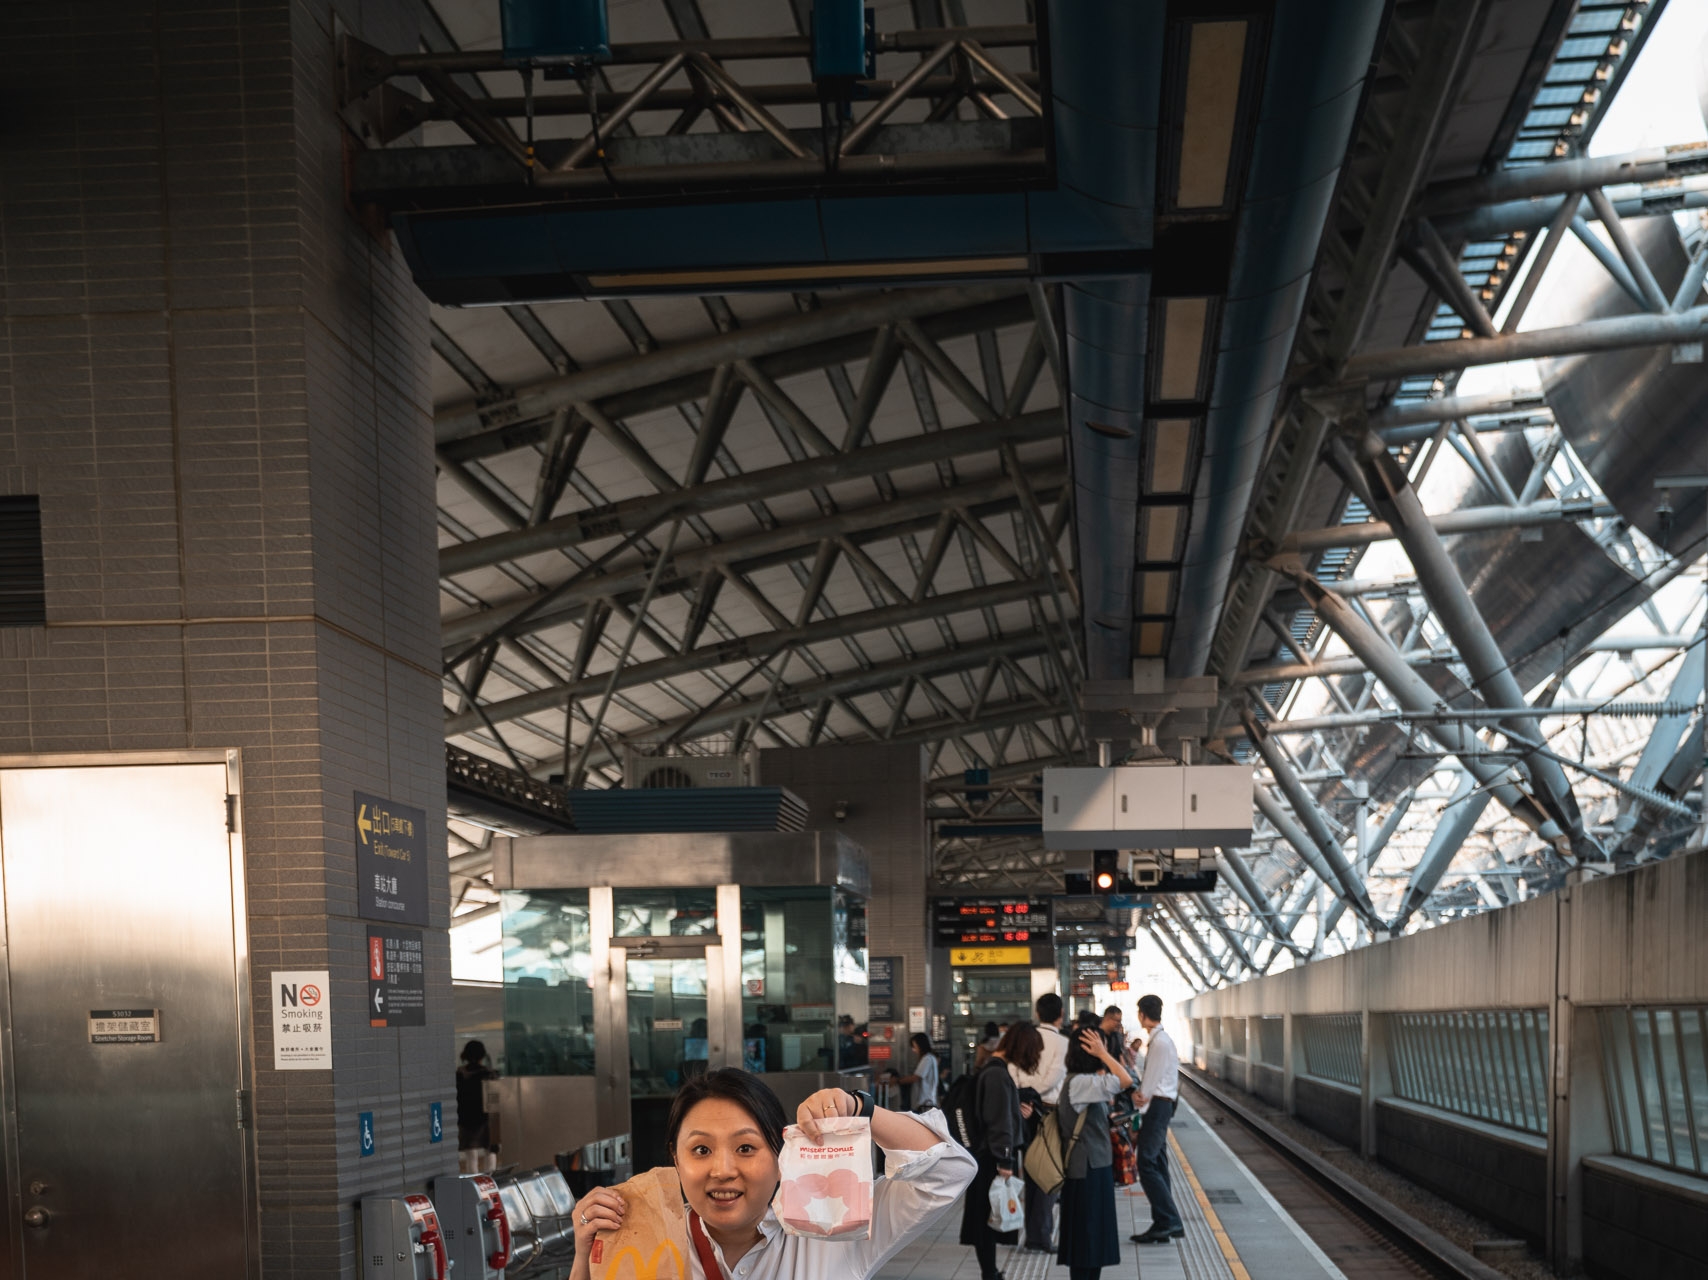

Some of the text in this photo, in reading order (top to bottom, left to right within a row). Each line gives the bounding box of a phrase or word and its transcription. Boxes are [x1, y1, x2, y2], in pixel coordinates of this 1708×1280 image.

[374, 873, 398, 895] 車站大廳
[281, 1008, 323, 1020] Smoking
[282, 1023, 322, 1033] 禁止吸菸
